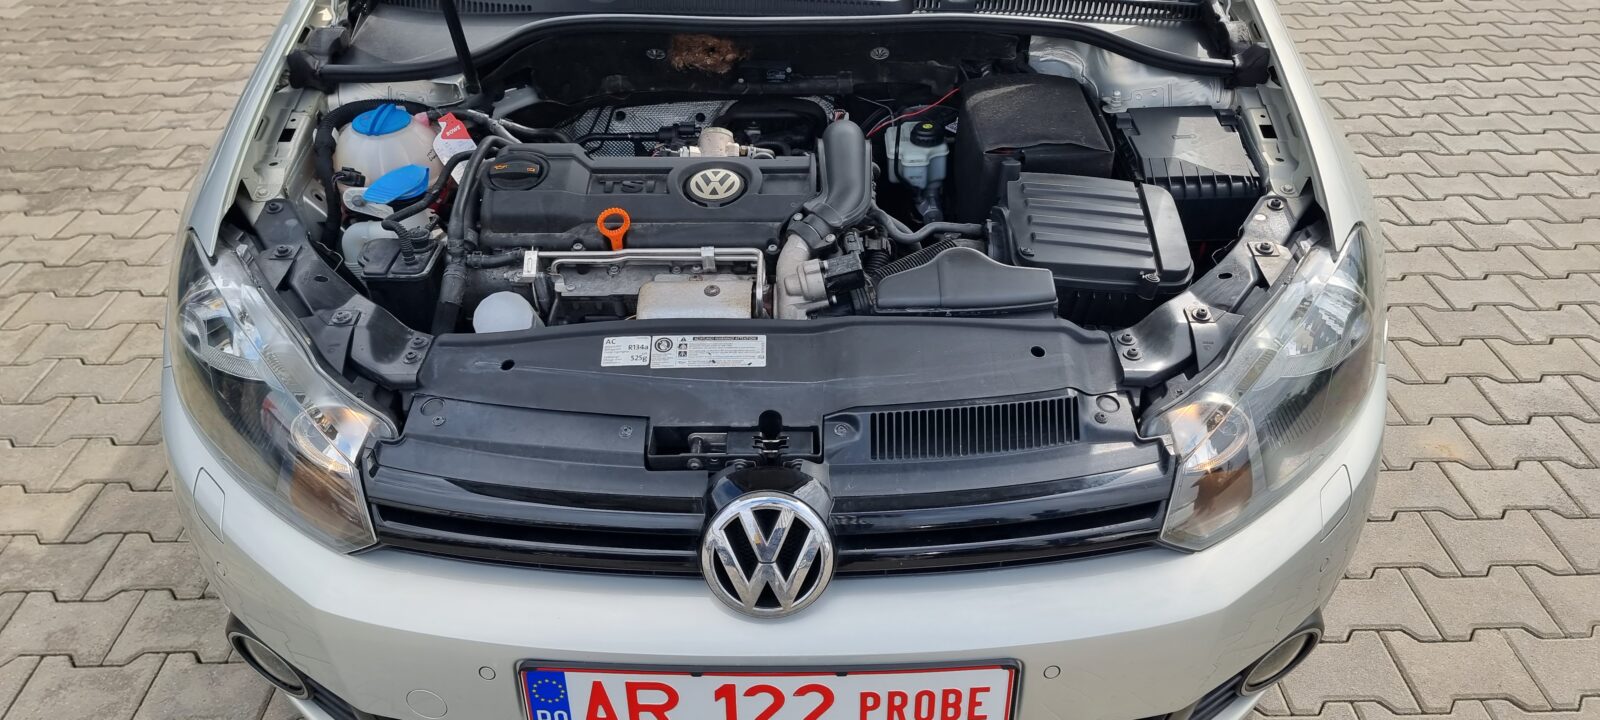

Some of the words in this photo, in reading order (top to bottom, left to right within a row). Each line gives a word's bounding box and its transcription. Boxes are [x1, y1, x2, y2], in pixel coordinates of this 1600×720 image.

[600, 180, 657, 194] TSI
[630, 355, 648, 363] 525g
[703, 491, 834, 618] VW
[585, 681, 680, 720] AR
[859, 687, 991, 720] PROBE
